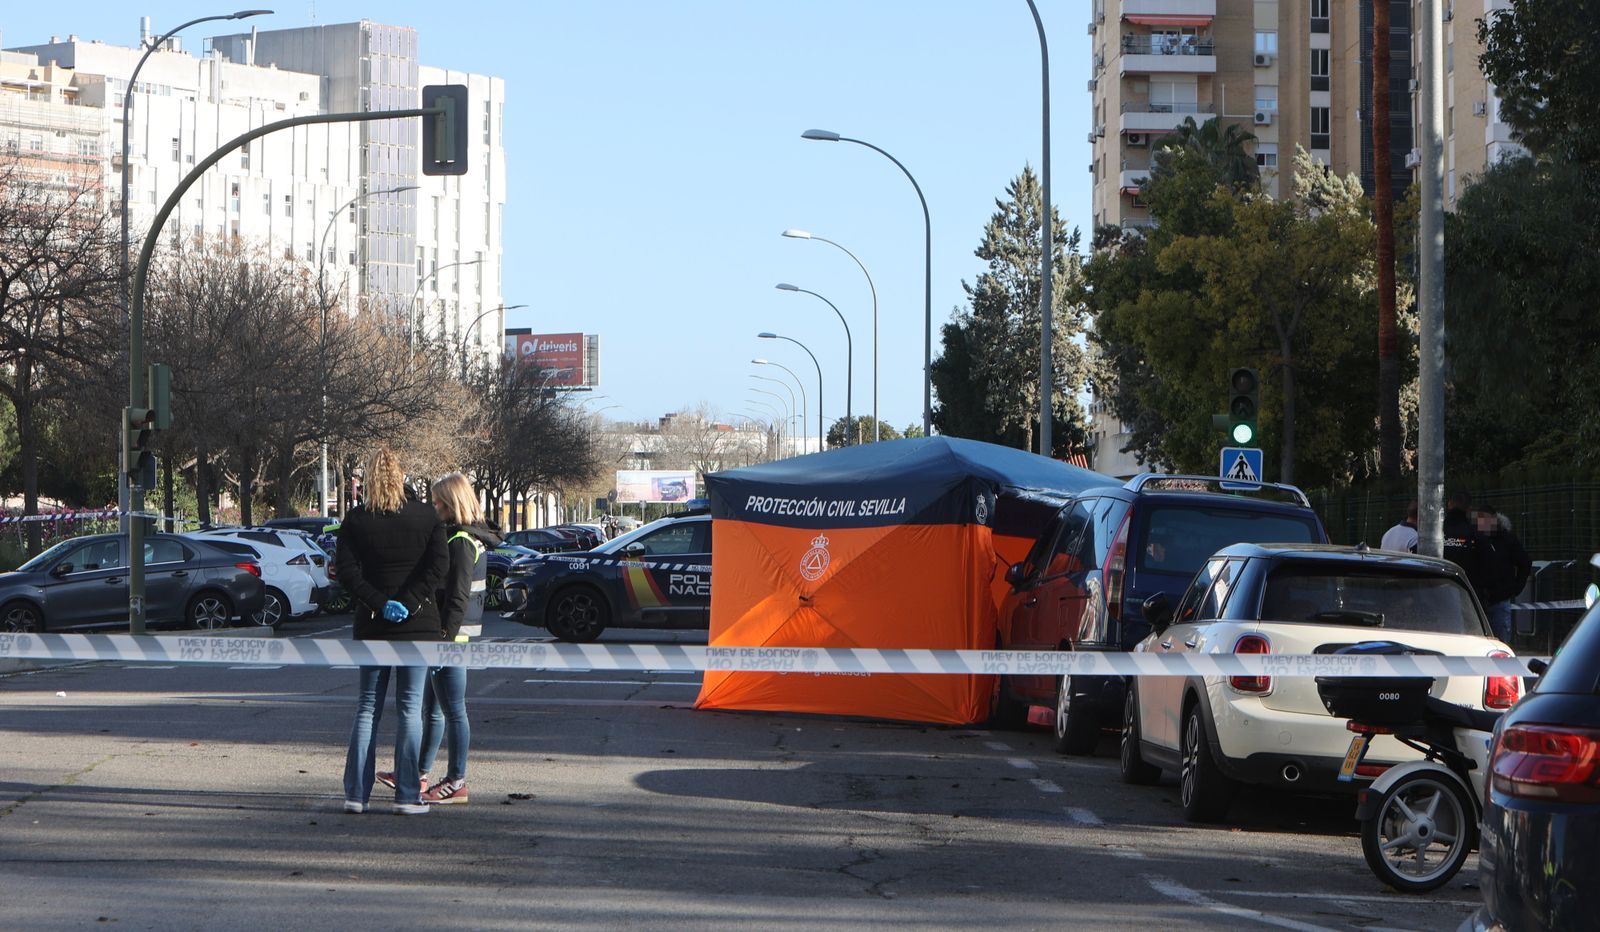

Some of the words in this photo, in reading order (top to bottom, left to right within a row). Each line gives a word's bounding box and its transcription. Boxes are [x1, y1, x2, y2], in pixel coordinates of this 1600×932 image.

[539, 340, 578, 352] driveris
[744, 495, 827, 517] PROTECCIÓN
[827, 500, 856, 517] CIVIL
[858, 497, 906, 517] SEVILLA
[1379, 692, 1400, 700] 0080
